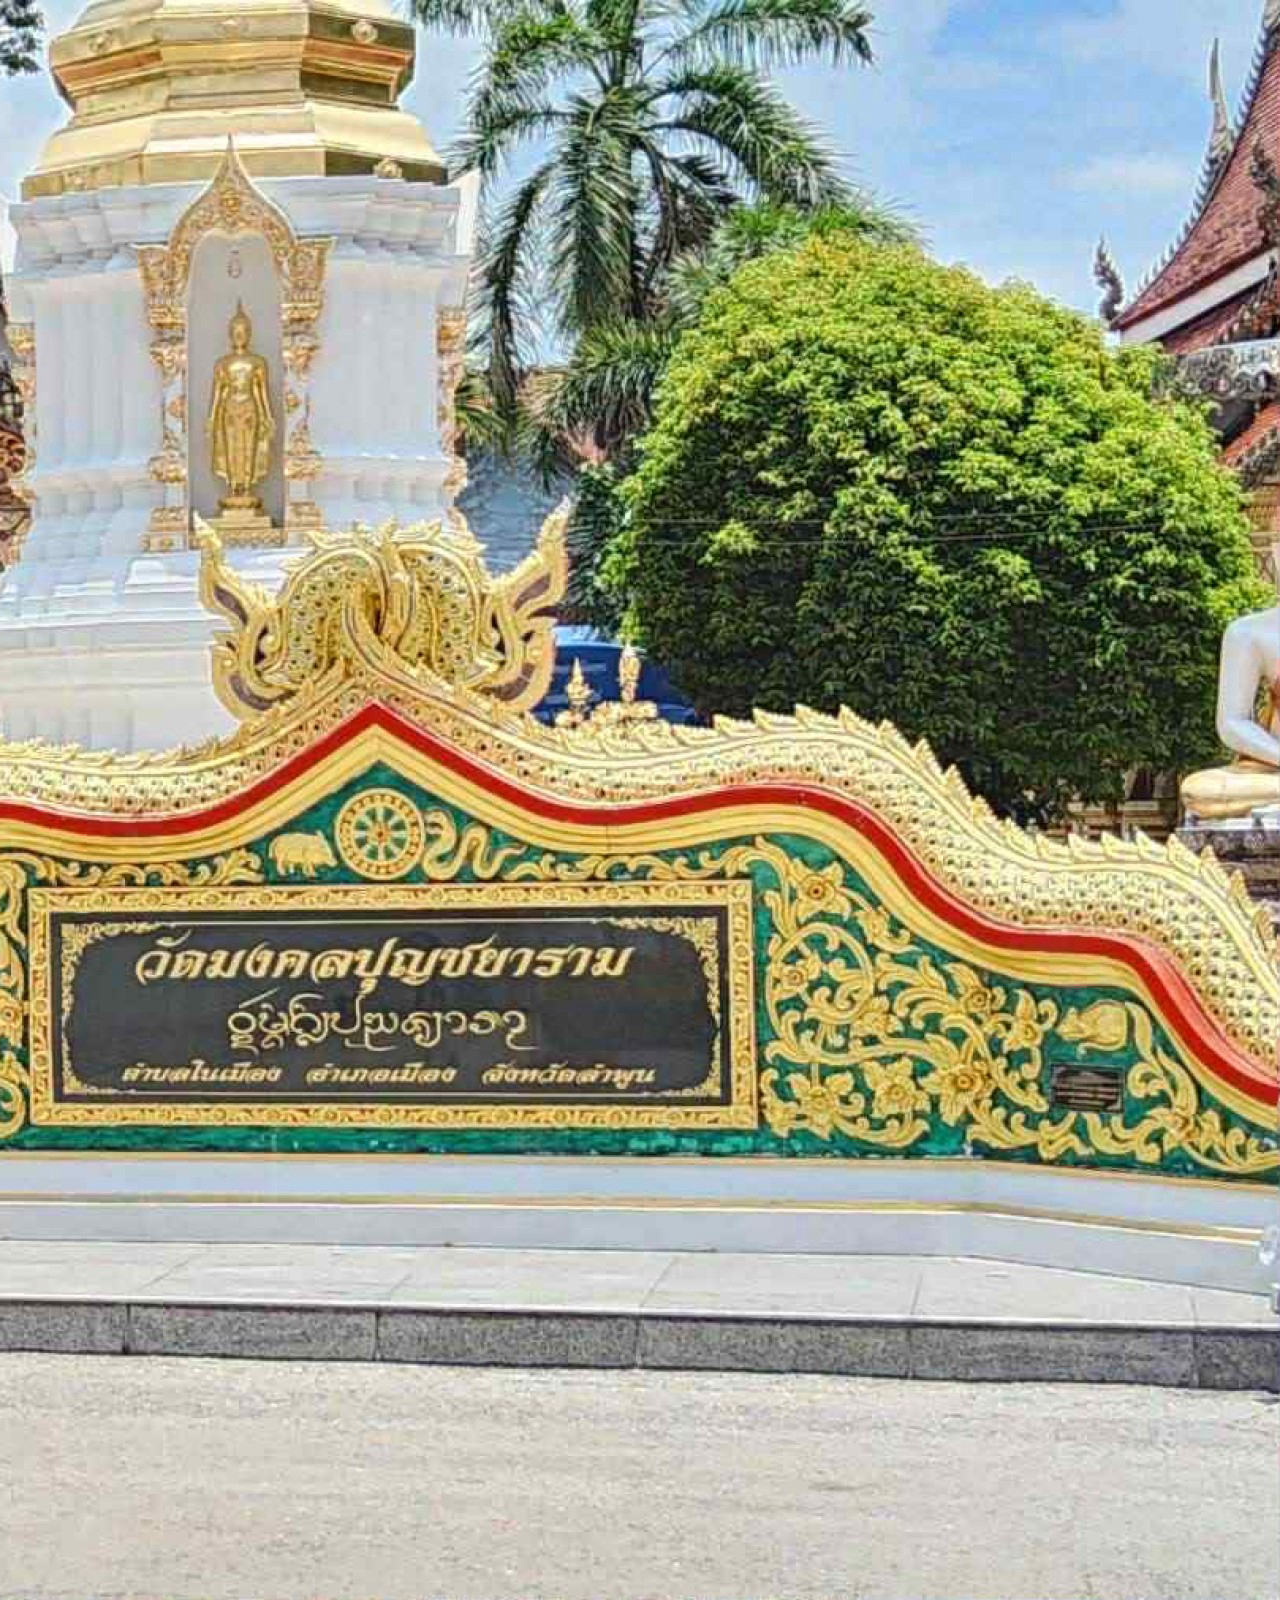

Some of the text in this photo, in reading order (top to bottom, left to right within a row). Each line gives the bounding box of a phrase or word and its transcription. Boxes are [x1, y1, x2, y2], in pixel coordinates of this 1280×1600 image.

[135, 928, 636, 995] วัดมงคลปุญชยาราม
[121, 1059, 657, 1089] ตำบลในเมือง อำเภอเมือง จังหวัดลำพูน
